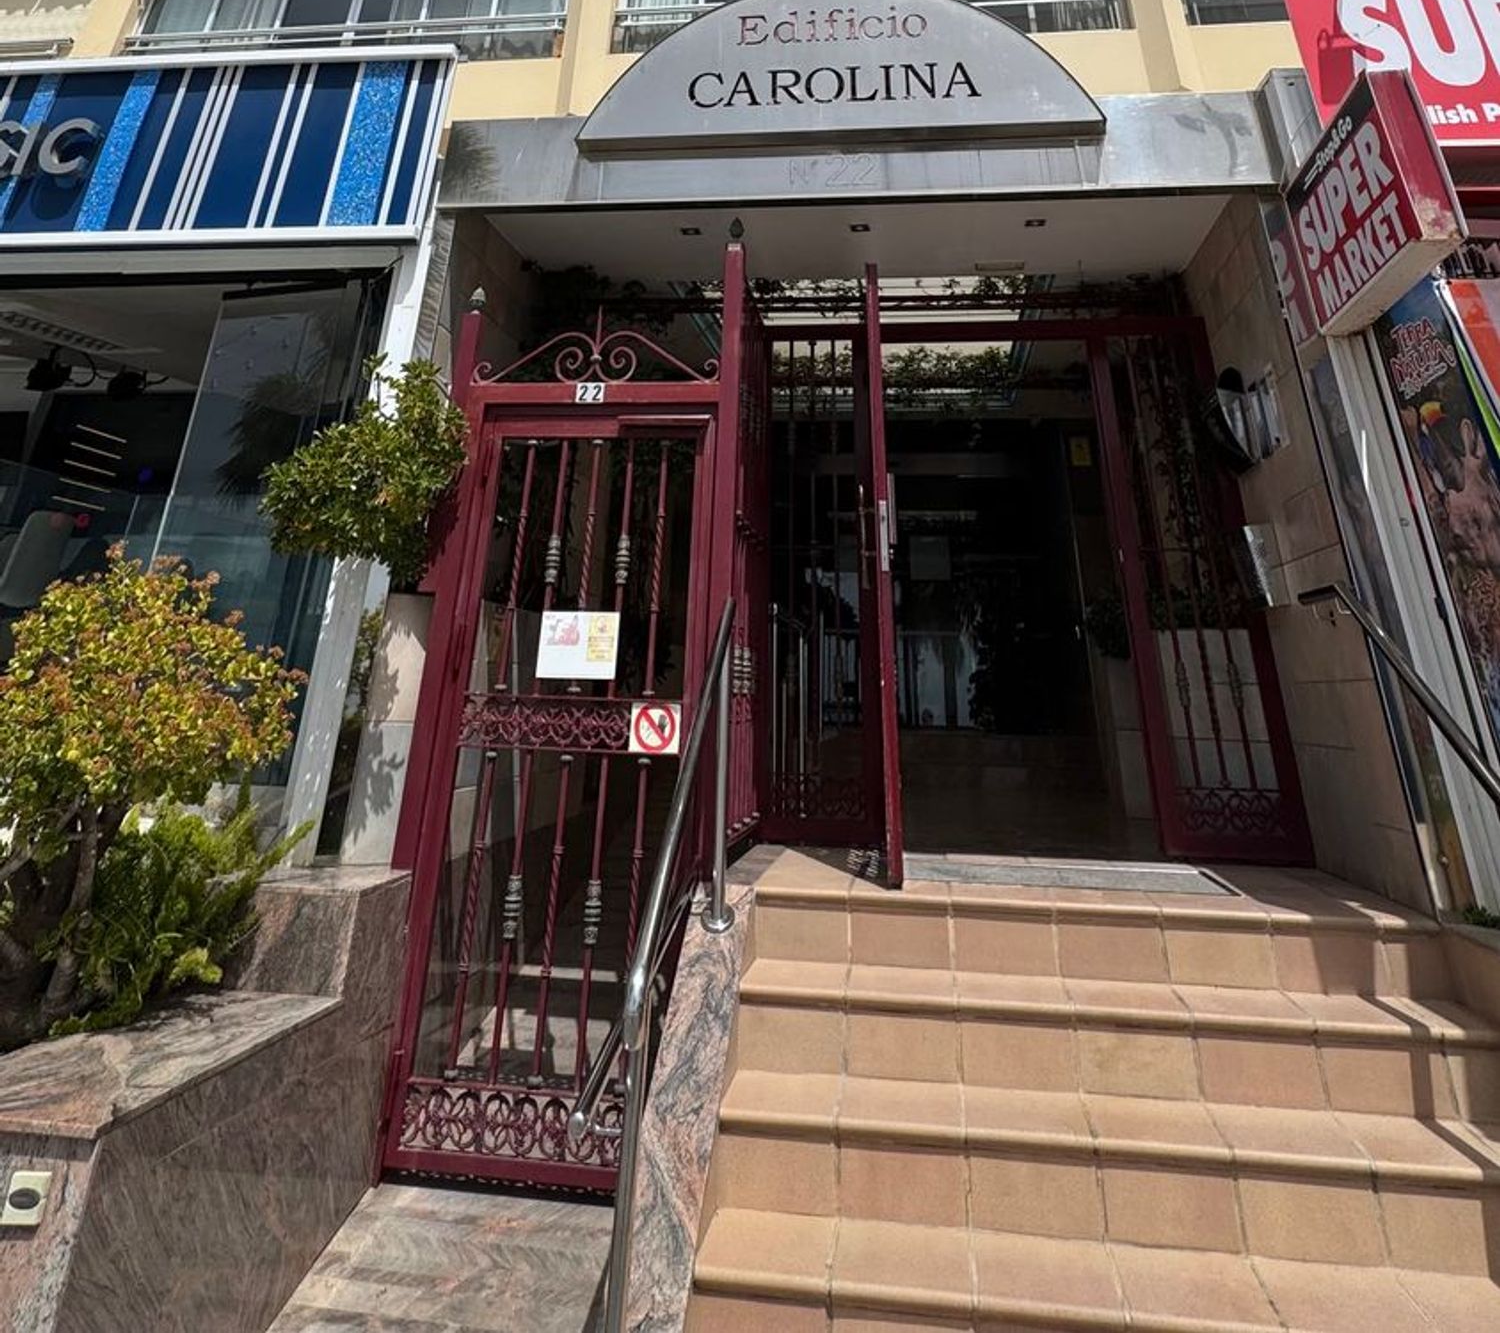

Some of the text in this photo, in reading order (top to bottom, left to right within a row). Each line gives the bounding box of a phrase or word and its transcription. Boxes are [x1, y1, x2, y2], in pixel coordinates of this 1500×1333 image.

[737, 7, 928, 46] Edificio
[688, 61, 982, 108] CAROLINA
[1301, 121, 1394, 271] SUPER
[1317, 190, 1409, 319] MARKET
[578, 384, 602, 401] 22
